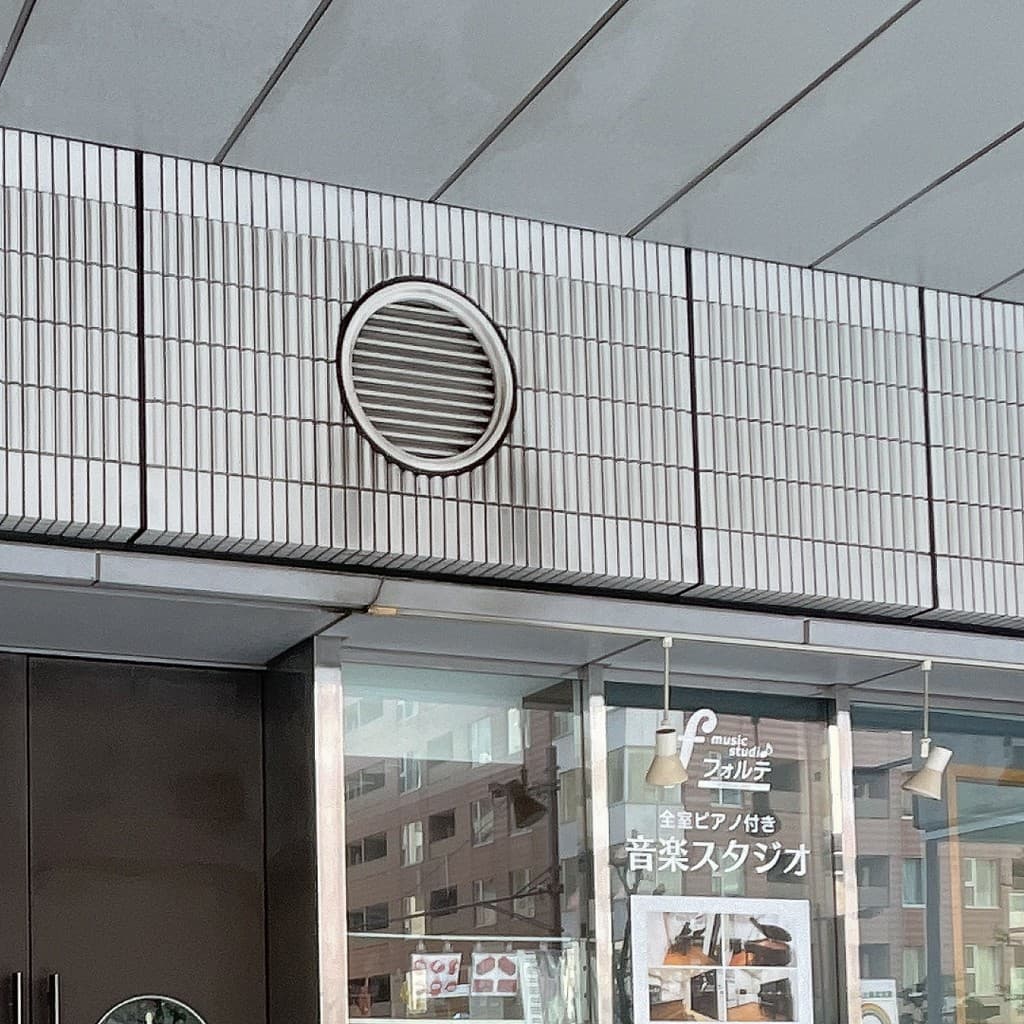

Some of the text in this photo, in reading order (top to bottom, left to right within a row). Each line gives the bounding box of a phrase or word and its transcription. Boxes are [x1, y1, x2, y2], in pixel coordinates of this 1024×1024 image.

[711, 735, 748, 746] music
[703, 757, 772, 781] フォルテ
[659, 809, 777, 834] 全室ピアノ付き
[625, 835, 811, 876] 音楽スタジオ
